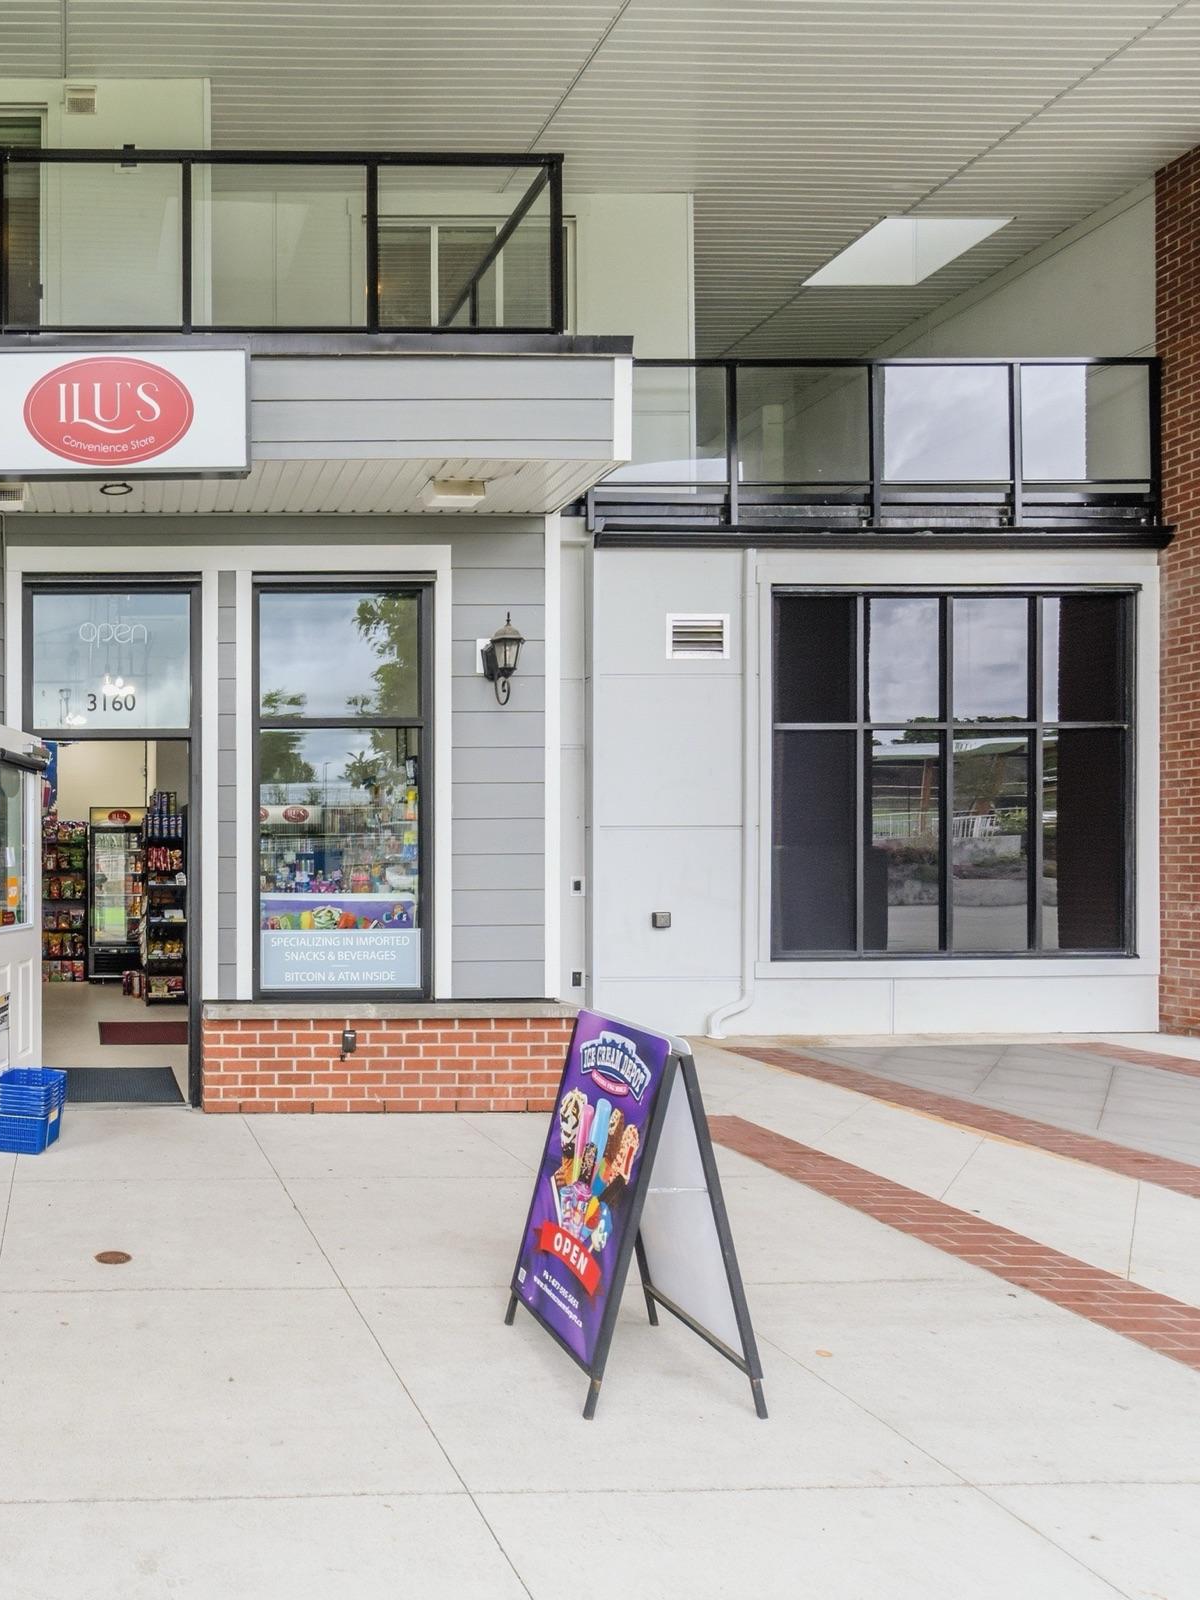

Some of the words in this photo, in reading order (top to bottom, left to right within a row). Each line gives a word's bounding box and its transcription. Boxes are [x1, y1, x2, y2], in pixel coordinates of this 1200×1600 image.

[57, 382, 161, 434] ILU'S
[62, 435, 129, 453] Convenience
[130, 435, 155, 450] Store
[79, 622, 148, 648] open
[86, 693, 136, 711] 3160
[271, 936, 341, 948] SPECIALIZING
[342, 936, 354, 947] IN
[356, 935, 410, 946] IMPORTED
[284, 951, 326, 961] SNACKS
[327, 951, 336, 961] &
[337, 950, 397, 961] BEVERAGES
[284, 972, 326, 982] BITCOIN
[327, 972, 336, 981] &
[337, 972, 360, 982] ATM
[362, 971, 397, 981] INSIDE
[583, 1046, 597, 1069] ICE
[596, 1046, 623, 1072] CREAM
[620, 1054, 646, 1093] DEPOT
[553, 1232, 588, 1276] OPEN
